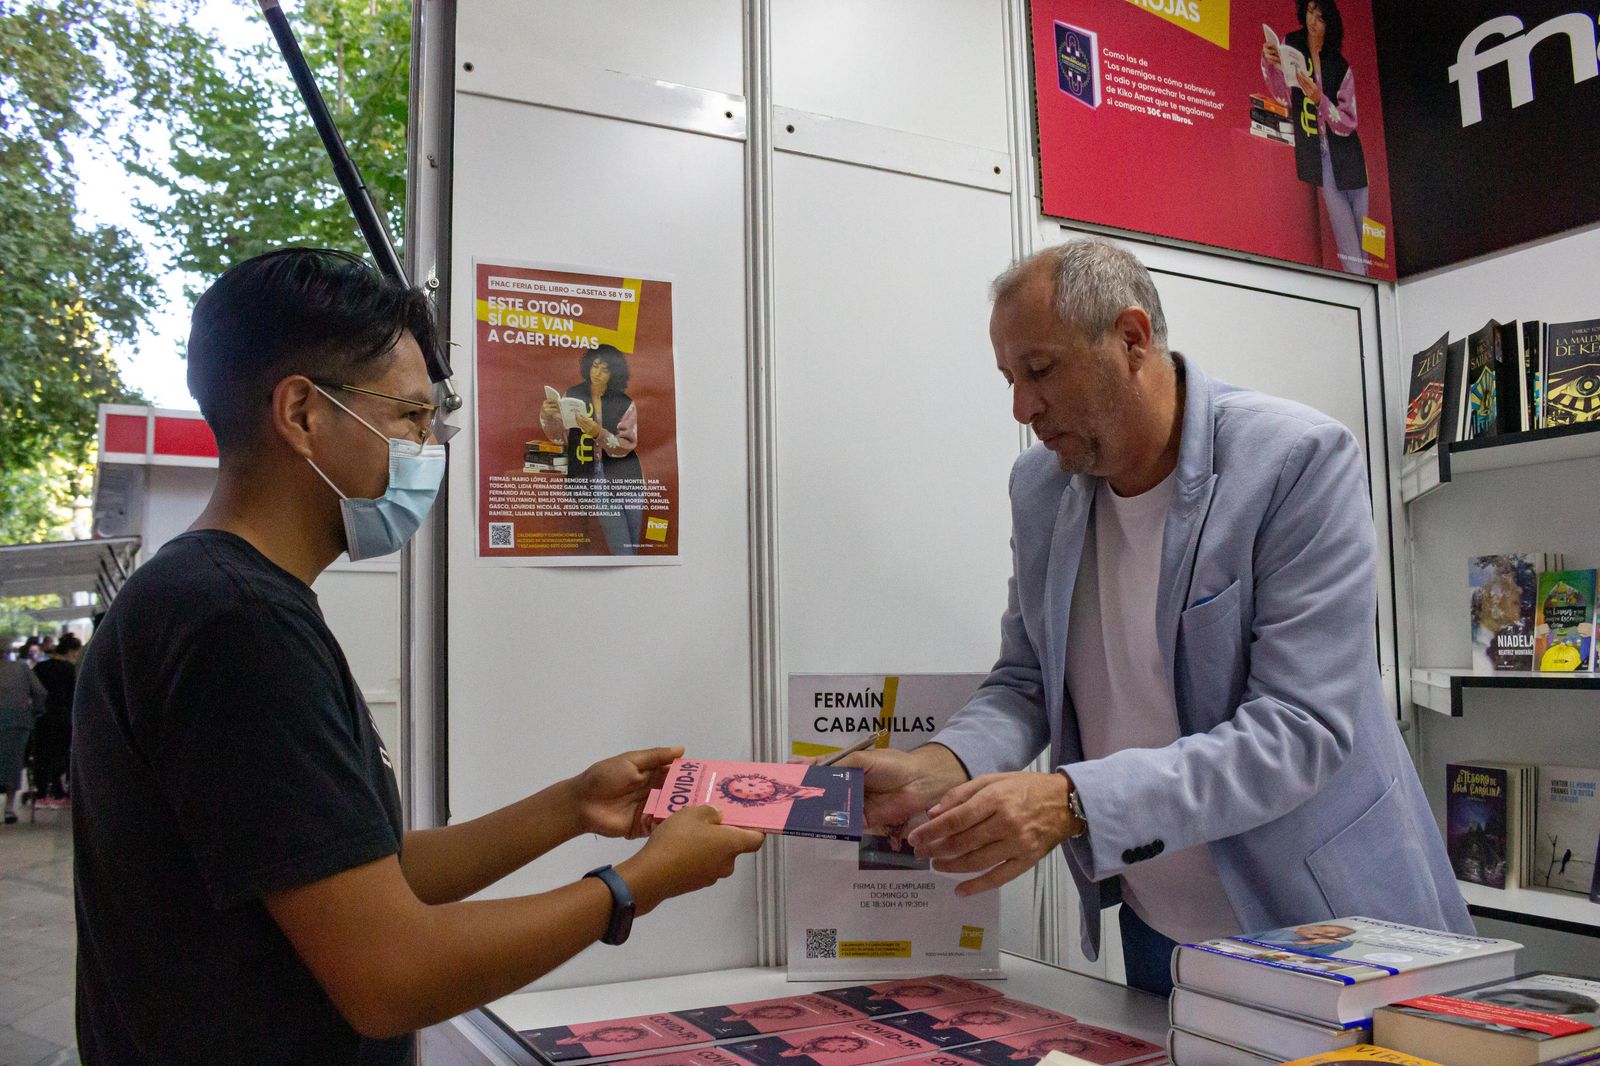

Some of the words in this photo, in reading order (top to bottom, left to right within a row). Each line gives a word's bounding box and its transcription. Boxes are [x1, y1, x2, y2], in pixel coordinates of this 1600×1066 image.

[1103, 48, 1125, 61] Como
[1126, 54, 1137, 64] las
[1138, 58, 1148, 67] de
[1448, 12, 1600, 128] fn
[1105, 73, 1113, 81] al
[1113, 75, 1131, 86] odio
[1131, 80, 1136, 89] y
[1137, 81, 1178, 98] aprovechar
[1178, 91, 1186, 100] la
[1121, 66, 1156, 81] enemigos
[1163, 75, 1183, 88] cómo
[1184, 82, 1216, 97] sobrevivir
[1105, 84, 1116, 94] de
[1117, 87, 1133, 98] Kiko
[1134, 92, 1153, 104] Amat
[1155, 98, 1169, 109] que
[1170, 101, 1177, 110] te
[1178, 103, 1215, 119] regalamos
[1106, 97, 1113, 105] si
[1114, 100, 1146, 114] compras
[1146, 106, 1161, 117] 30€
[1162, 112, 1172, 121] en
[1172, 113, 1194, 126] libros.
[490, 280, 510, 288] FNAC
[512, 281, 532, 290] FERIA
[534, 283, 547, 291] DEL
[548, 285, 569, 293] LIBRO
[576, 288, 607, 297] CASETAS
[488, 296, 524, 312] ESTE
[527, 299, 584, 317] OTOÑO
[488, 309, 502, 326] SÍ
[506, 314, 539, 329] QUE
[541, 316, 574, 332] VAN
[488, 329, 500, 343] A
[503, 330, 545, 346] CAER
[549, 333, 600, 350] HOJAS
[1556, 338, 1568, 346] LA
[1555, 345, 1576, 357] DE
[1579, 343, 1600, 355] KE
[648, 520, 668, 529] fnac
[1497, 634, 1534, 648] NIADELA
[814, 687, 884, 709] FERMÍN
[814, 716, 936, 733] CABANILLAS
[853, 882, 876, 890] FIRMA
[877, 882, 888, 890] DE
[889, 882, 936, 890] EJEMPLARES
[870, 891, 909, 899] DOMINGO
[911, 891, 919, 899] 10
[860, 900, 871, 908] DE
[855, 1023, 923, 1050] COVID-19:
